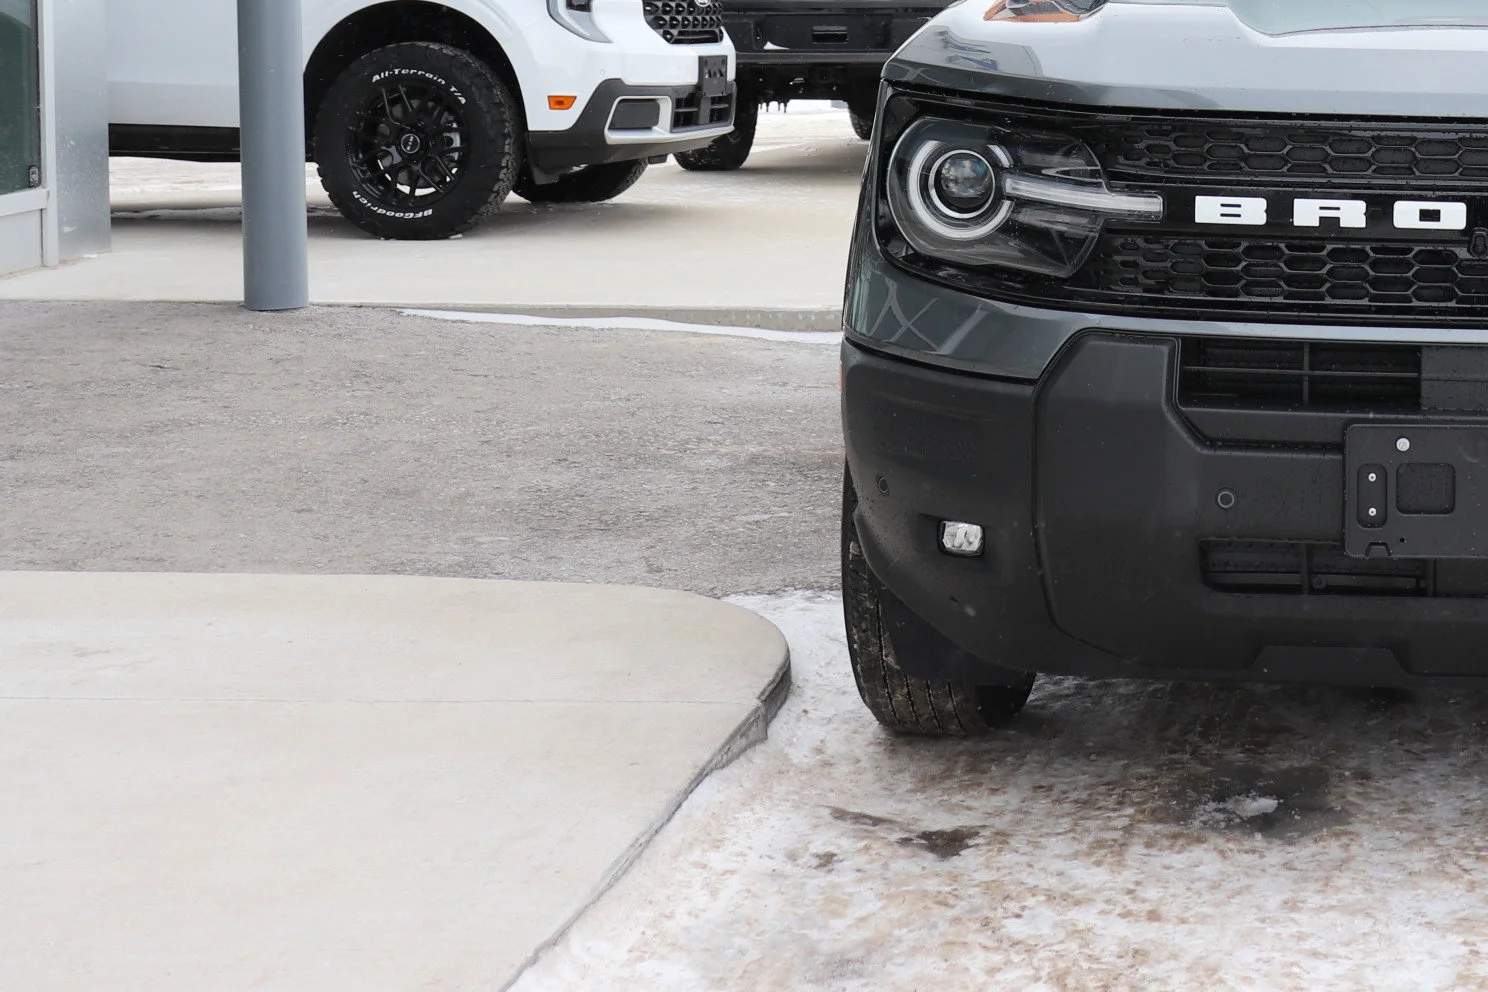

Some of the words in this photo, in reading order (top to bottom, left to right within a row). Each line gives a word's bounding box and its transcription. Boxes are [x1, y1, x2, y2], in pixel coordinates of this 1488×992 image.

[372, 68, 446, 85] All-Terrain
[449, 85, 467, 105] T/A
[352, 190, 433, 219] BFGoodrich
